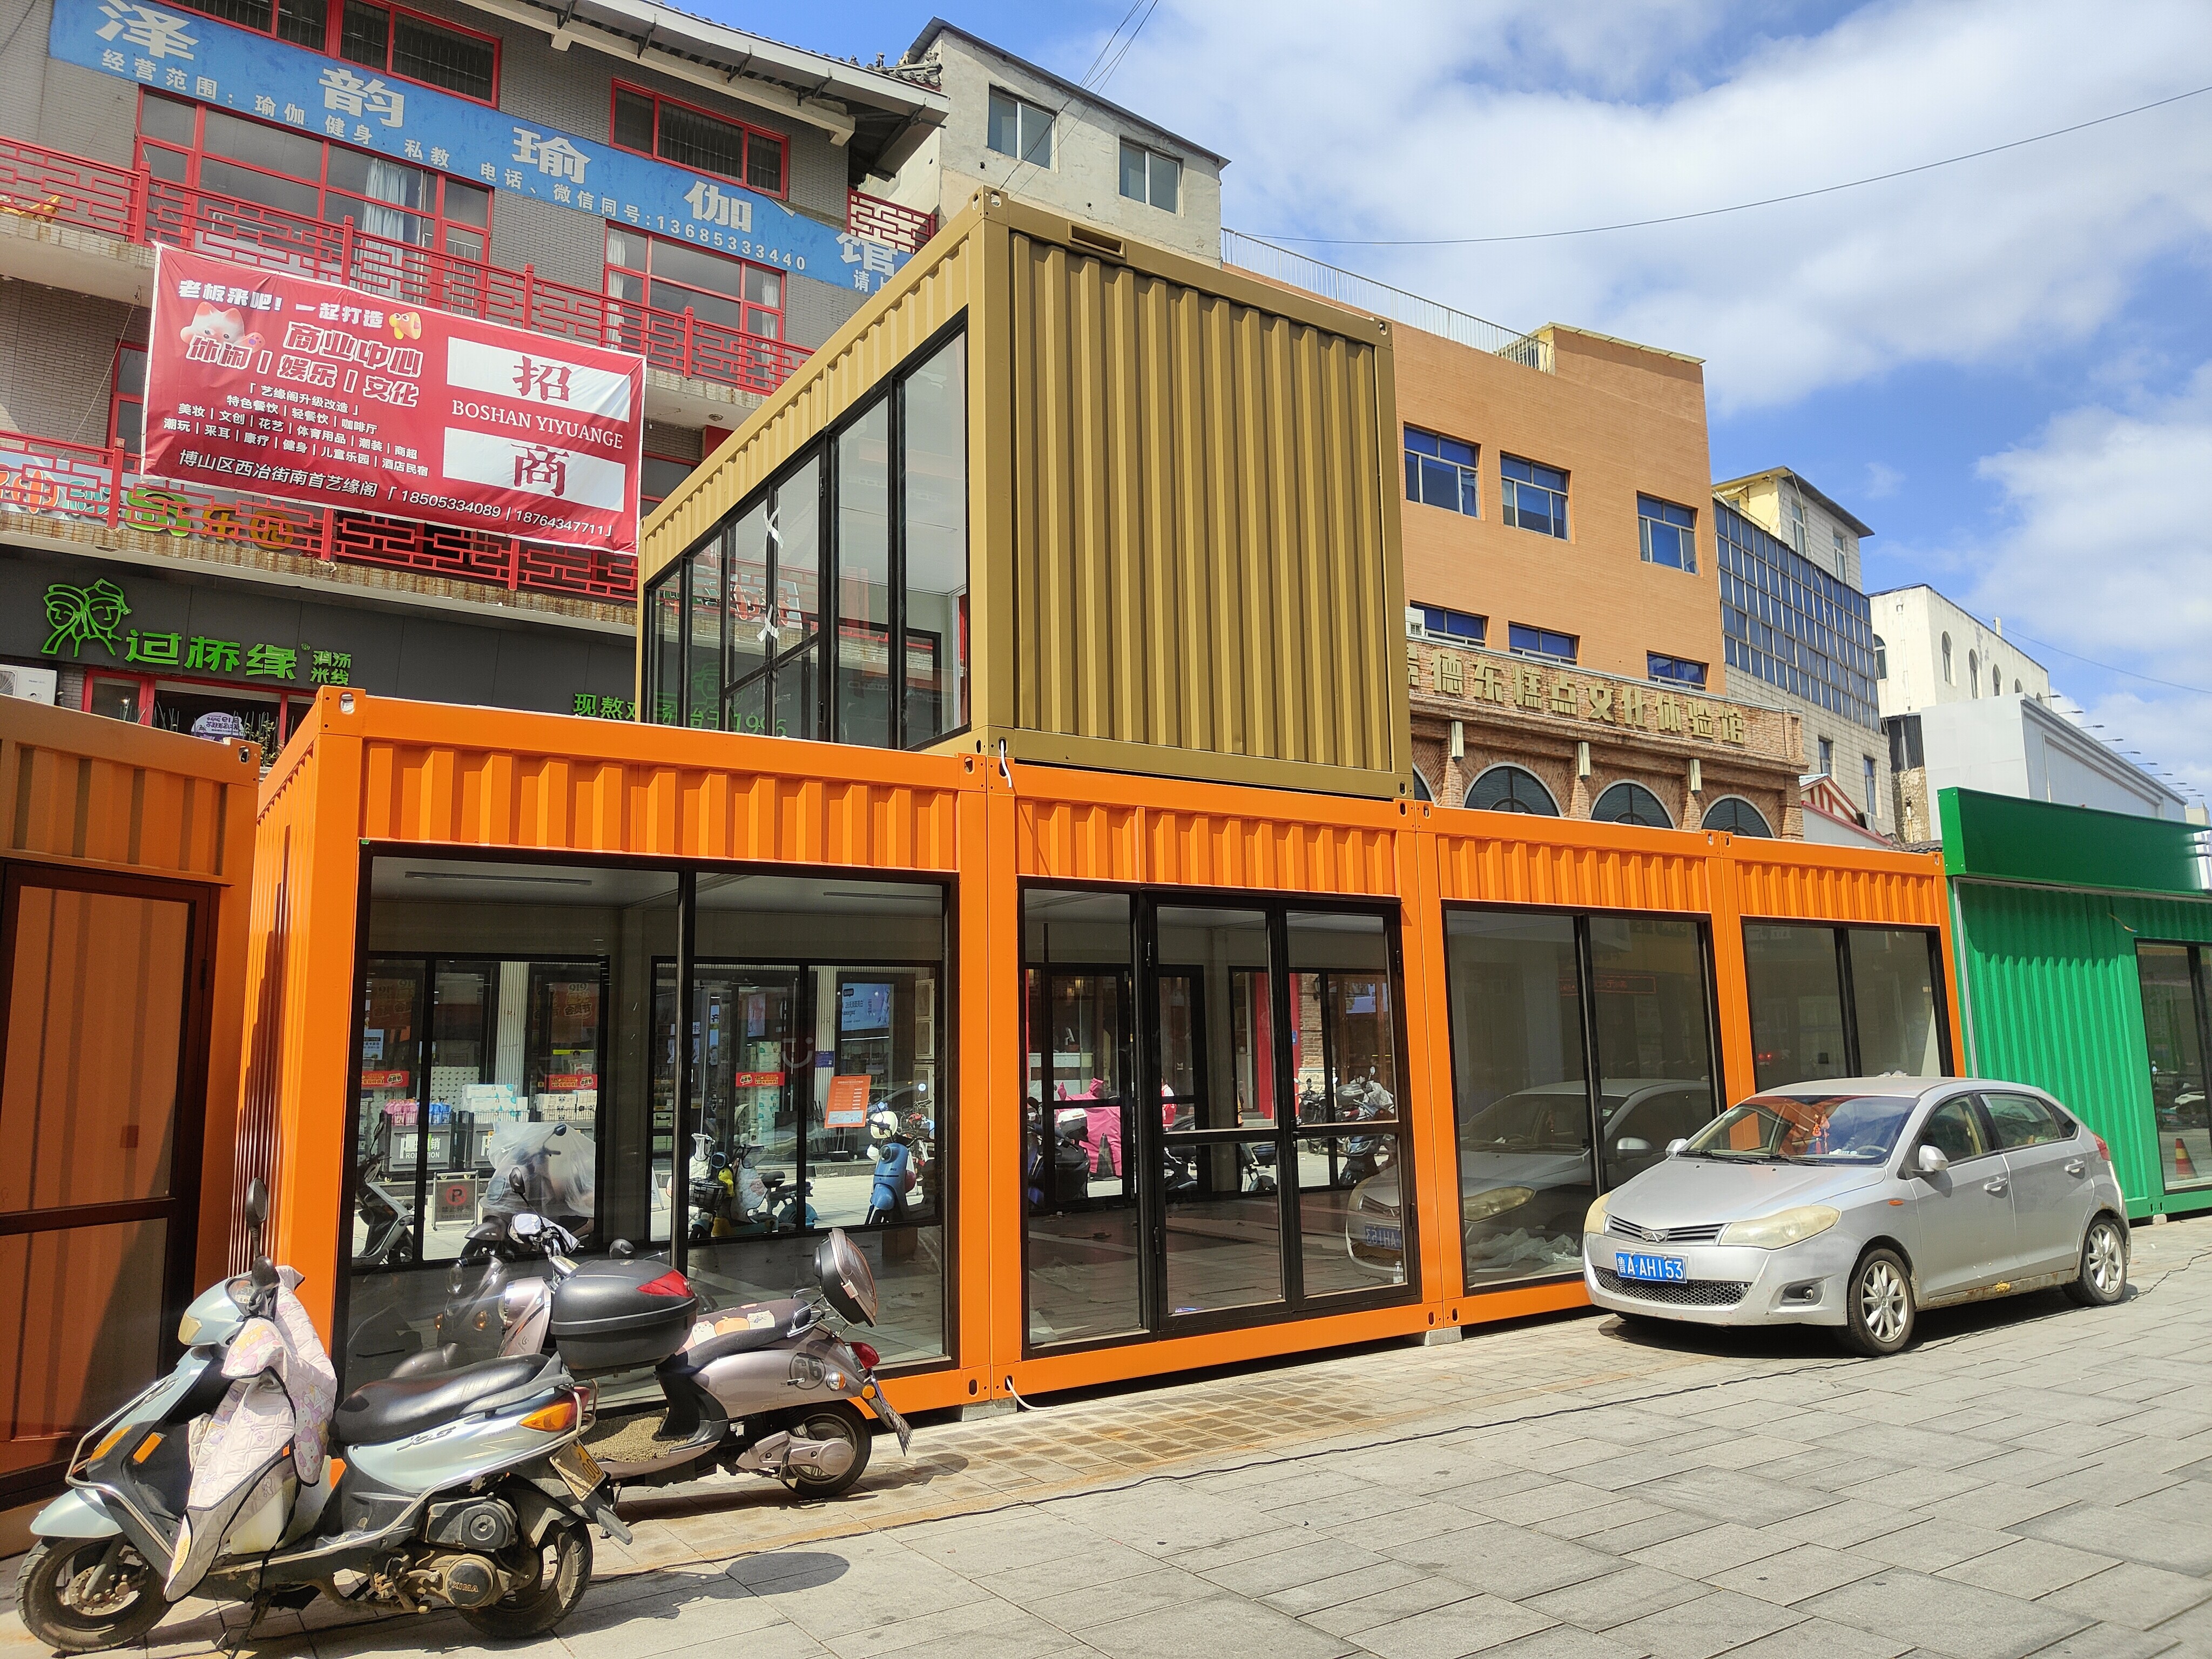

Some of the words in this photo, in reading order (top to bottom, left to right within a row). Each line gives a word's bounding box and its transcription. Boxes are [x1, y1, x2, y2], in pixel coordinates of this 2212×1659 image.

[254, 93, 306, 126] 瑜伽
[325, 116, 372, 146] 健身
[404, 139, 450, 170] 私教
[295, 302, 385, 328] 一起打造
[186, 335, 252, 369] 休闲
[276, 355, 338, 388] 娱乐
[363, 375, 419, 407] 文化
[282, 321, 424, 378] 商业中心
[511, 355, 572, 402] 招
[178, 402, 206, 419] 美妆
[219, 410, 245, 426] 文创
[258, 417, 285, 433] 花艺
[296, 424, 347, 445] 体育用品
[394, 444, 418, 460] 商超
[226, 394, 279, 415] 特色餐饮
[292, 407, 329, 426] 轻餐饮
[341, 418, 378, 435] 咖啡厅
[451, 400, 532, 429] BOSHAN
[535, 415, 624, 450] YIYUANGE
[163, 417, 191, 433] 潮玩
[204, 425, 231, 440] 采耳
[244, 431, 270, 447] 康疗
[282, 439, 308, 454] 健身
[320, 446, 370, 466] 儿童乐园
[382, 457, 429, 477] 酒店民宿
[510, 442, 570, 497] 商
[179, 449, 378, 498] 博山区西冶街南首艺缘阁
[124, 628, 297, 680] 过桥缘
[309, 667, 349, 686] 米线
[312, 650, 352, 669] 鸡汤
[564, 1003, 592, 1016] 会员节
[569, 983, 588, 992] 919
[451, 1581, 479, 1593] XIMA
